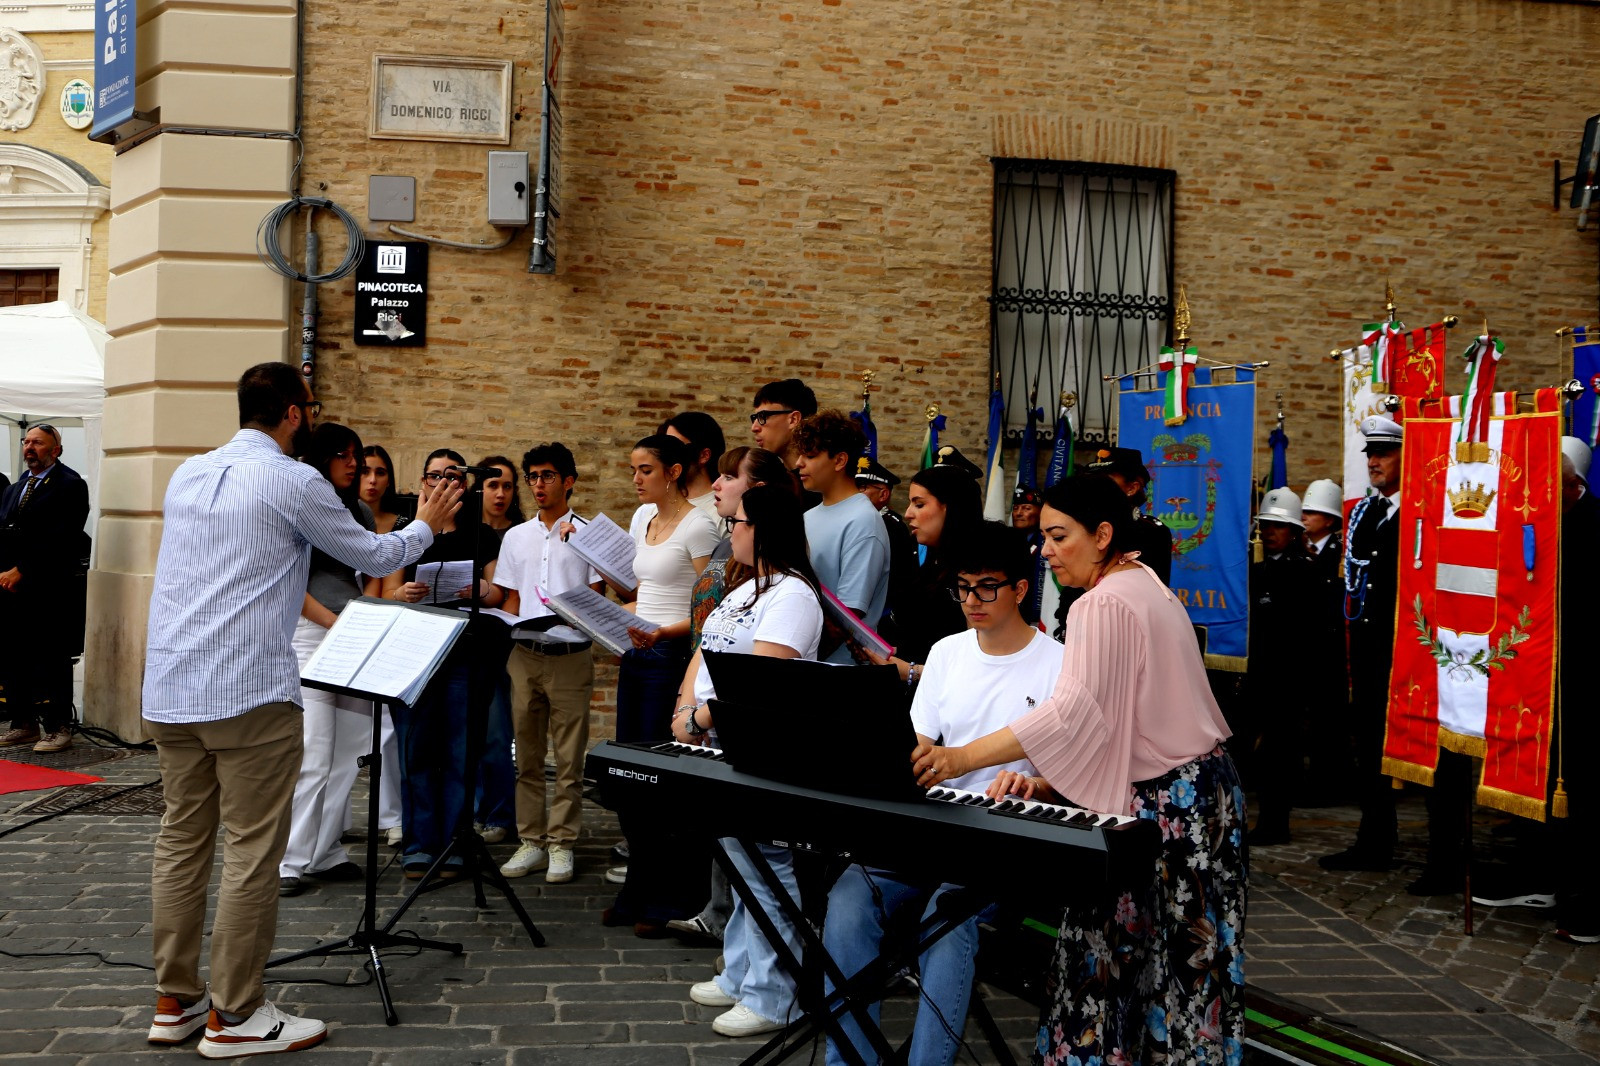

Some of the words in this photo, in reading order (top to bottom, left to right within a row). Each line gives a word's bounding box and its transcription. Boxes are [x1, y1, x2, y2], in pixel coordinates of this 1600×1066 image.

[433, 80, 451, 93] VIA
[391, 104, 452, 119] DOMENICO
[460, 107, 492, 121] RICCI
[358, 282, 423, 293] PINACOTECA
[371, 297, 409, 307] Palazzo
[1145, 402, 1222, 420] PRNCIA
